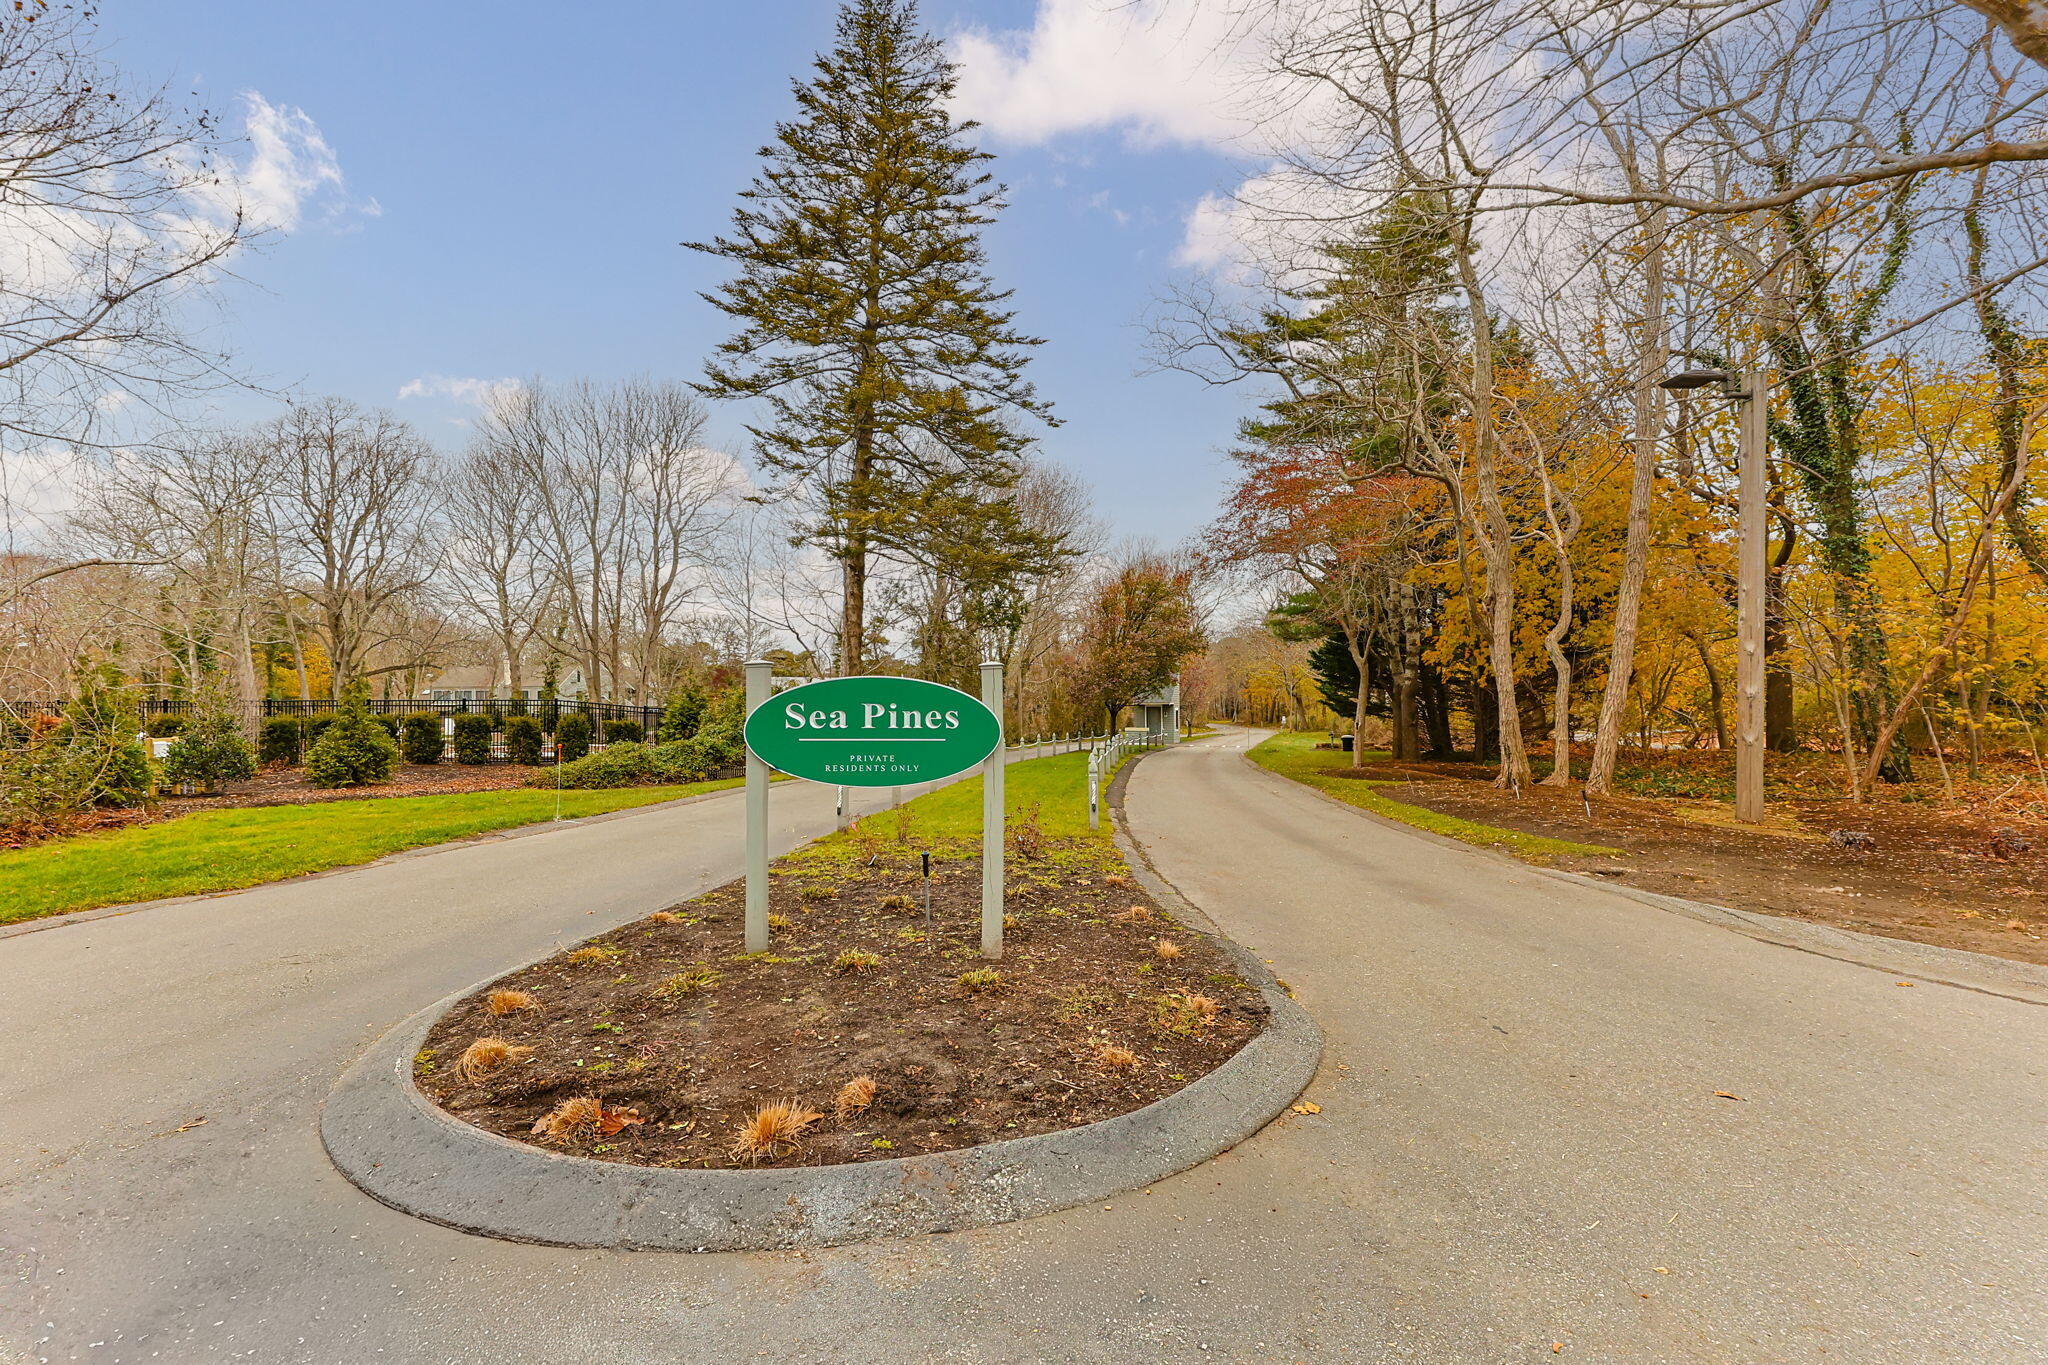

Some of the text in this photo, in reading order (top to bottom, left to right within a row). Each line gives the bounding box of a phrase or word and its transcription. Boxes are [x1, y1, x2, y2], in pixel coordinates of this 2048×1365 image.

[785, 702, 960, 730] Sea Pines
[849, 754, 895, 762] PRIVATE
[825, 764, 919, 773] RESIDENTS ONLY
